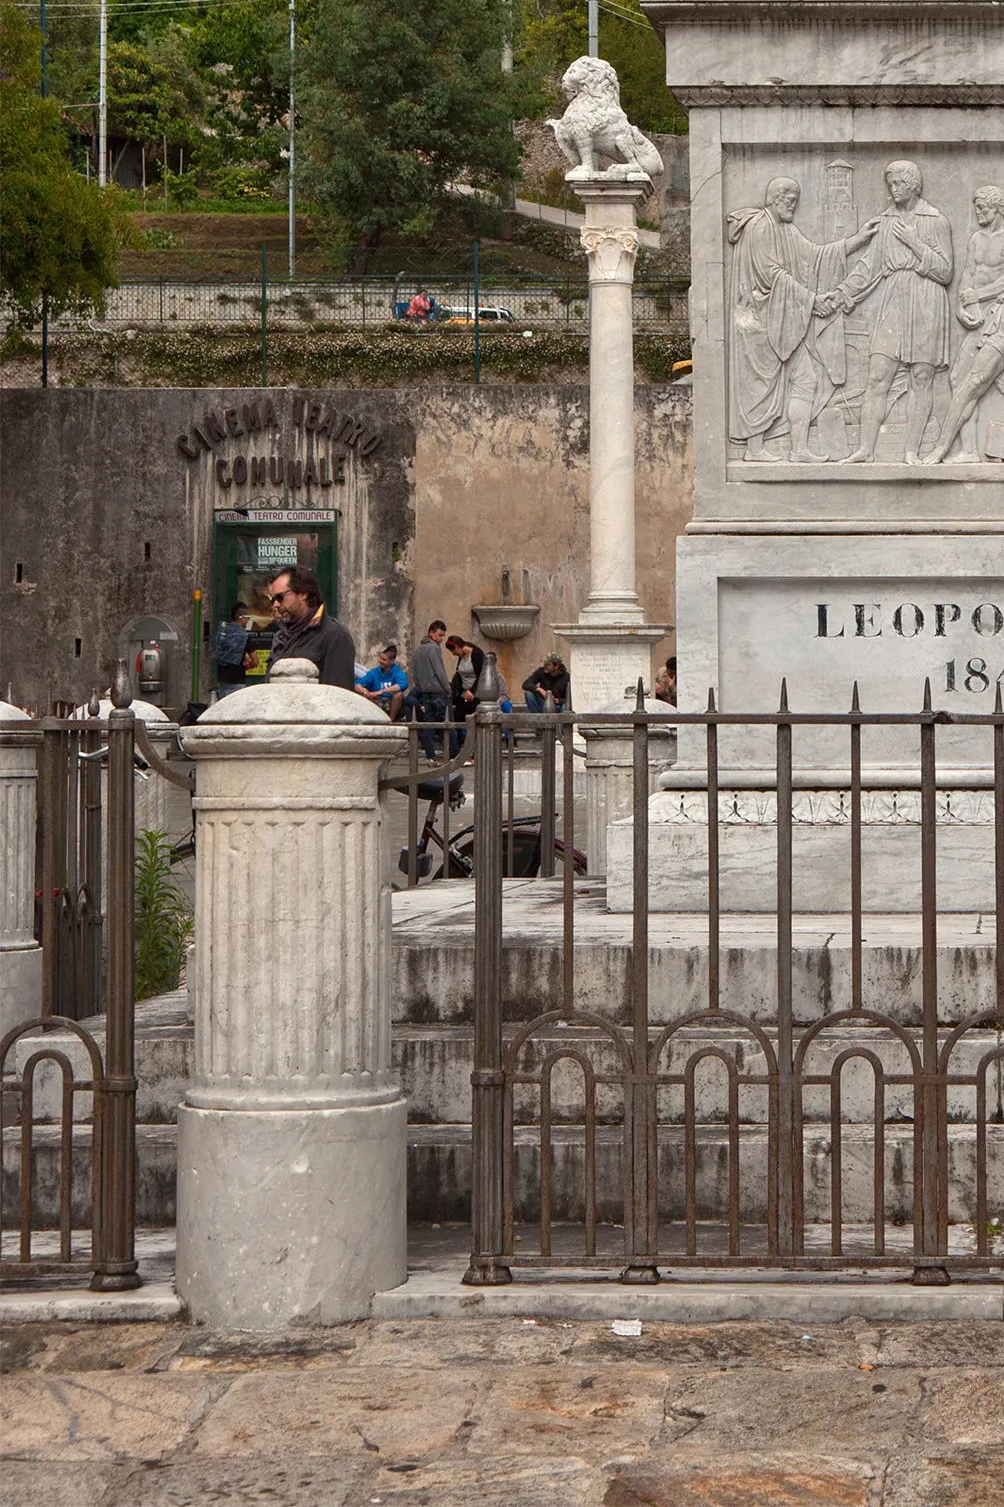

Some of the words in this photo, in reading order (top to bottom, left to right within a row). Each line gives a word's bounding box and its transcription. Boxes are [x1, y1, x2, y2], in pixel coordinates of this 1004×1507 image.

[177, 398, 278, 459] CINEMA
[292, 396, 383, 456] TEATRO
[216, 455, 345, 488] COMUNALE
[254, 512, 283, 520] TEATRO
[287, 512, 331, 520] COMUNALE
[258, 546, 297, 556] HUNGER
